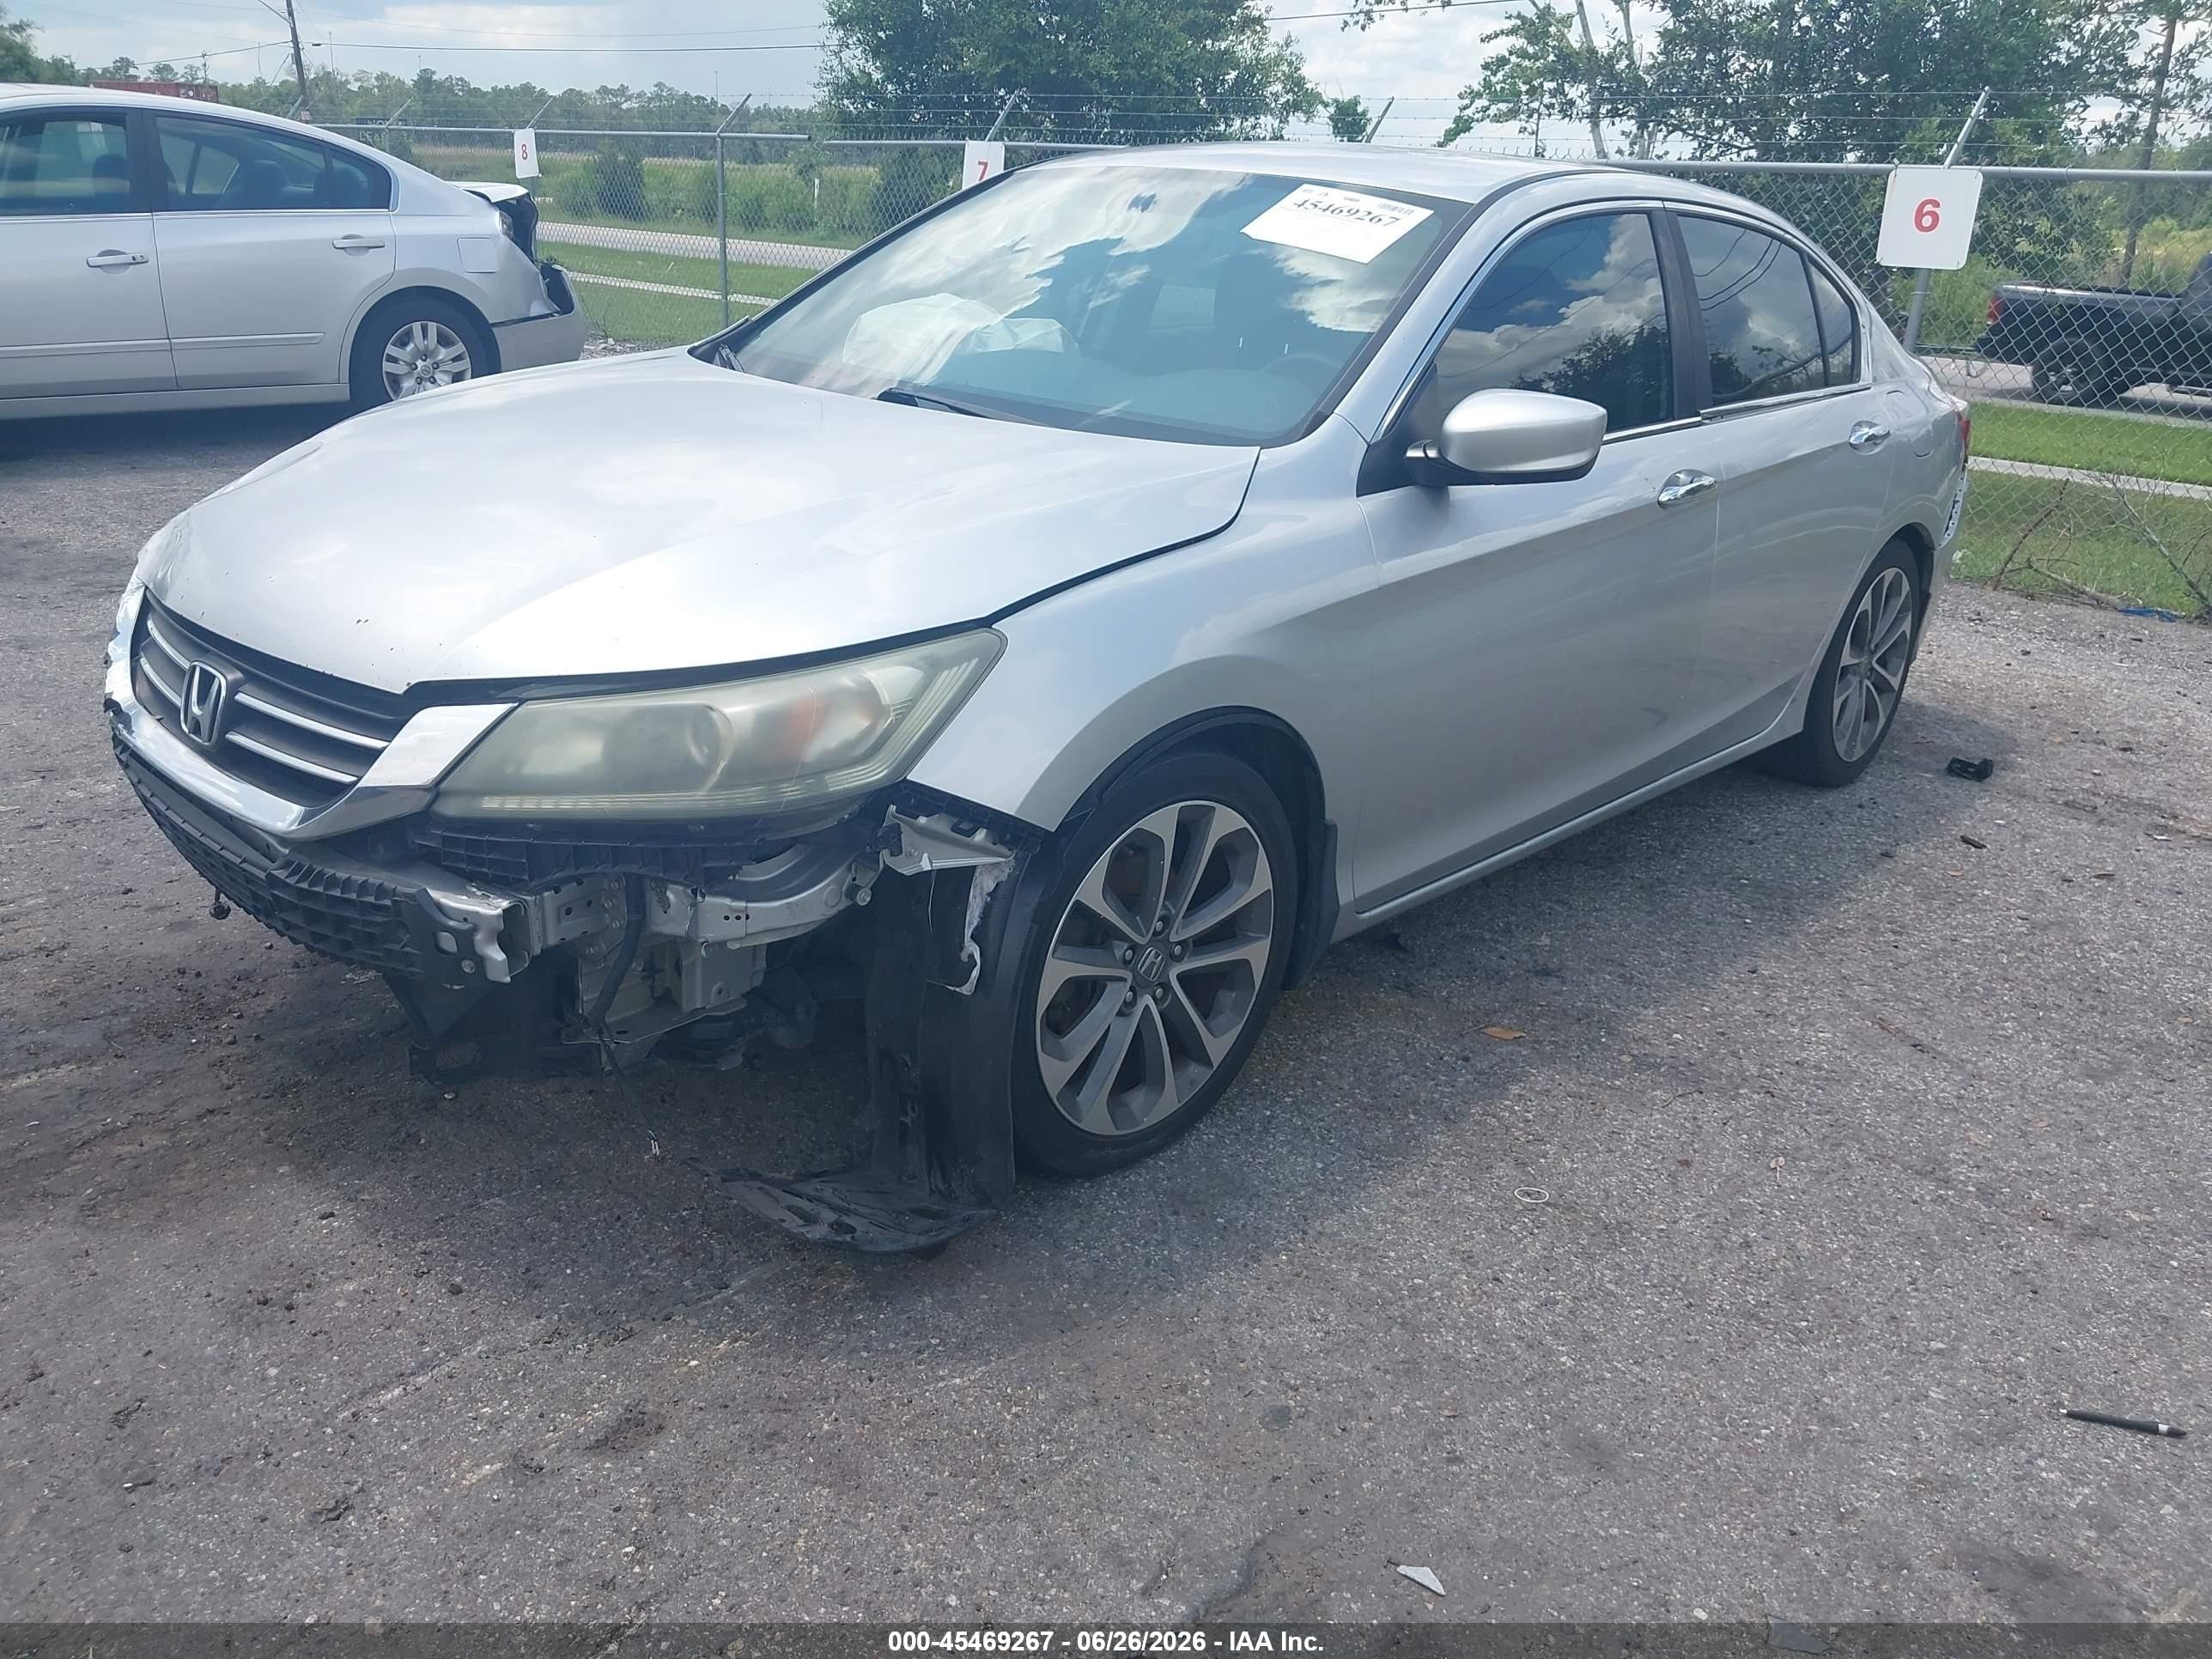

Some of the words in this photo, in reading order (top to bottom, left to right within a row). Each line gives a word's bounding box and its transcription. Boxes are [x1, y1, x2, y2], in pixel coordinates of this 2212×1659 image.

[521, 143, 528, 160] 8
[977, 161, 988, 181] 7
[1293, 198, 1401, 227] 45469267
[1914, 198, 1941, 233] 6
